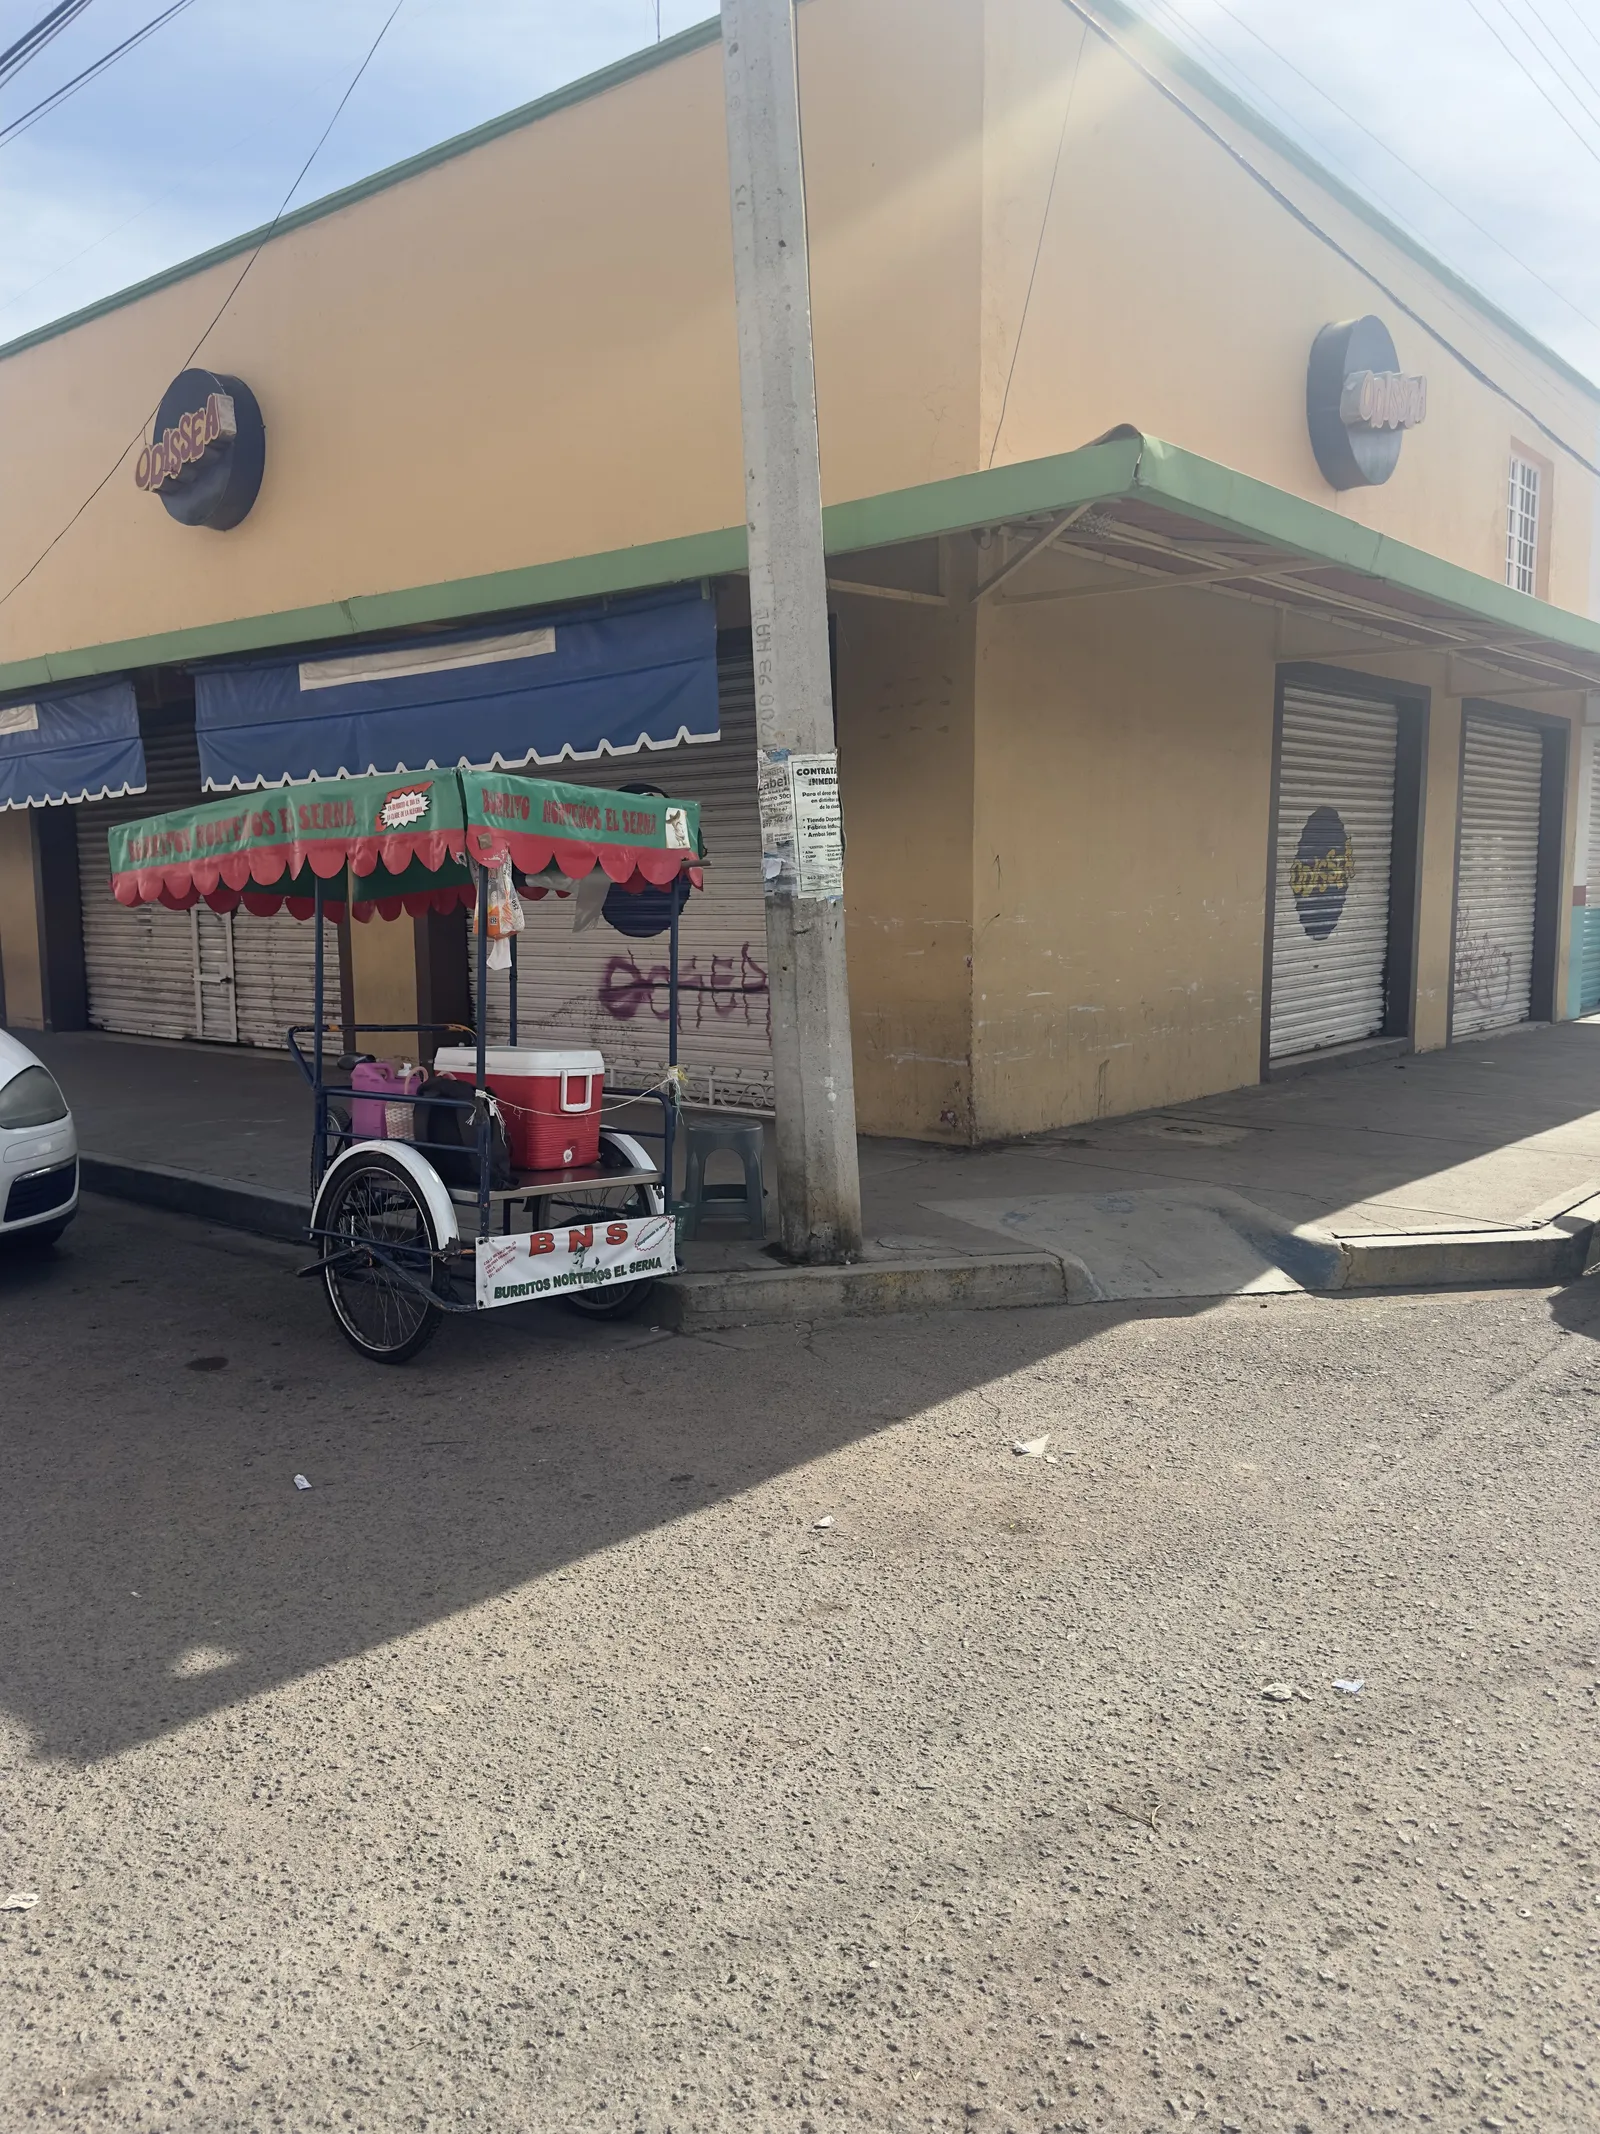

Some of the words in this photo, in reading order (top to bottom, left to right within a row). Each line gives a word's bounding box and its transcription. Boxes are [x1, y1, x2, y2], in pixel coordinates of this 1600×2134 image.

[135, 392, 220, 491] ODISSEA
[298, 799, 357, 831] SERNA
[481, 788, 530, 821] BURRITO
[605, 807, 619, 832] EL
[622, 809, 657, 835] SERNA
[493, 1277, 551, 1300] BURRITOS
[553, 1266, 612, 1288] NORTEÑOS
[614, 1263, 628, 1278] EL
[629, 1256, 663, 1274] SERNA
